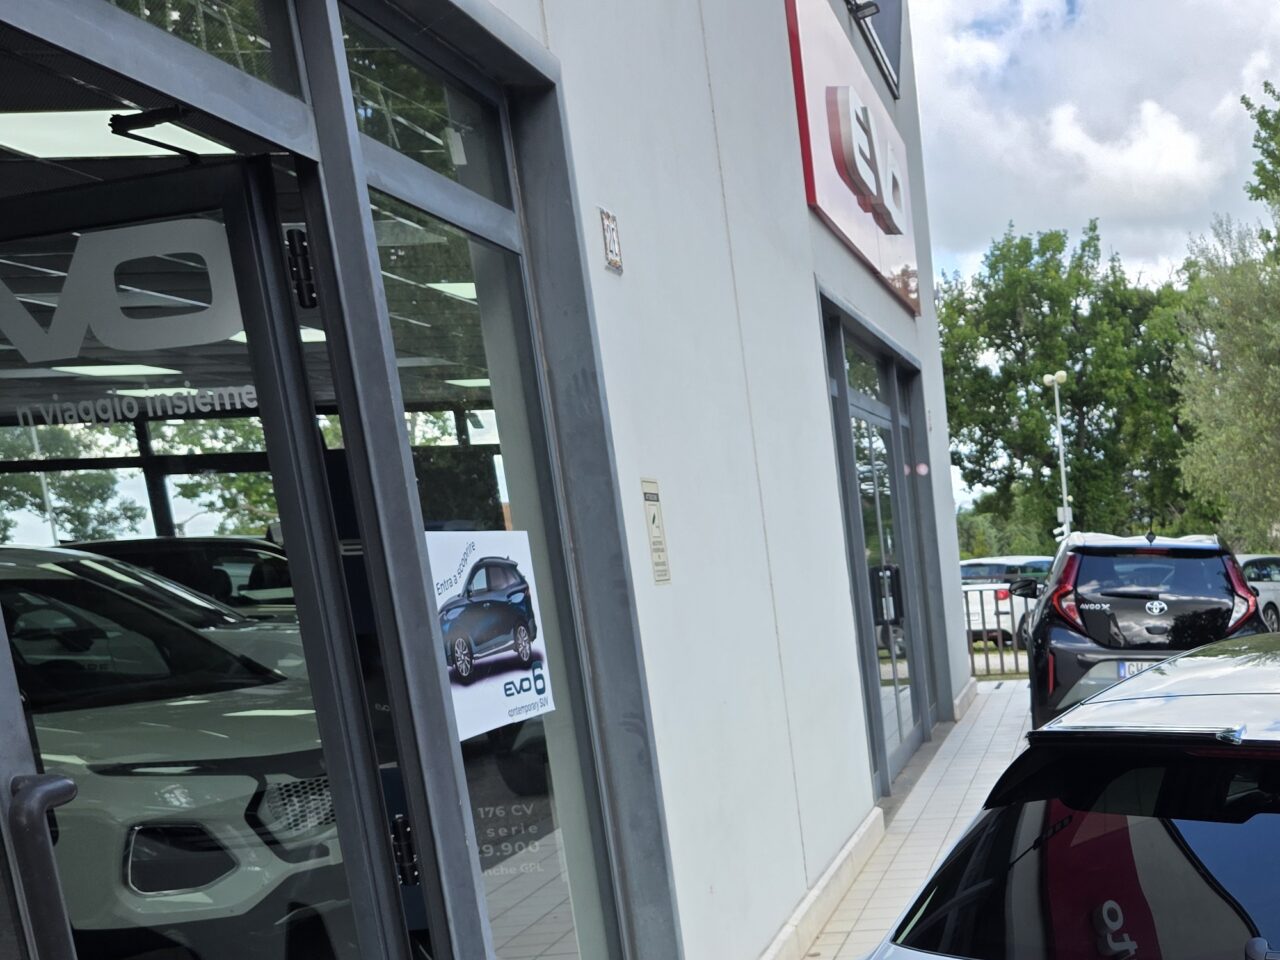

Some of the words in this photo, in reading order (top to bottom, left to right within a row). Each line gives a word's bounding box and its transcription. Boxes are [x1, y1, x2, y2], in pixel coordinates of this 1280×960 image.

[40, 387, 139, 428] viaggio
[144, 381, 258, 417] insieme
[503, 677, 532, 697] EVO
[532, 660, 546, 695] 6
[477, 806, 506, 819] 176
[510, 803, 534, 816] CV
[486, 822, 539, 838] serie
[479, 840, 540, 857] 9.900
